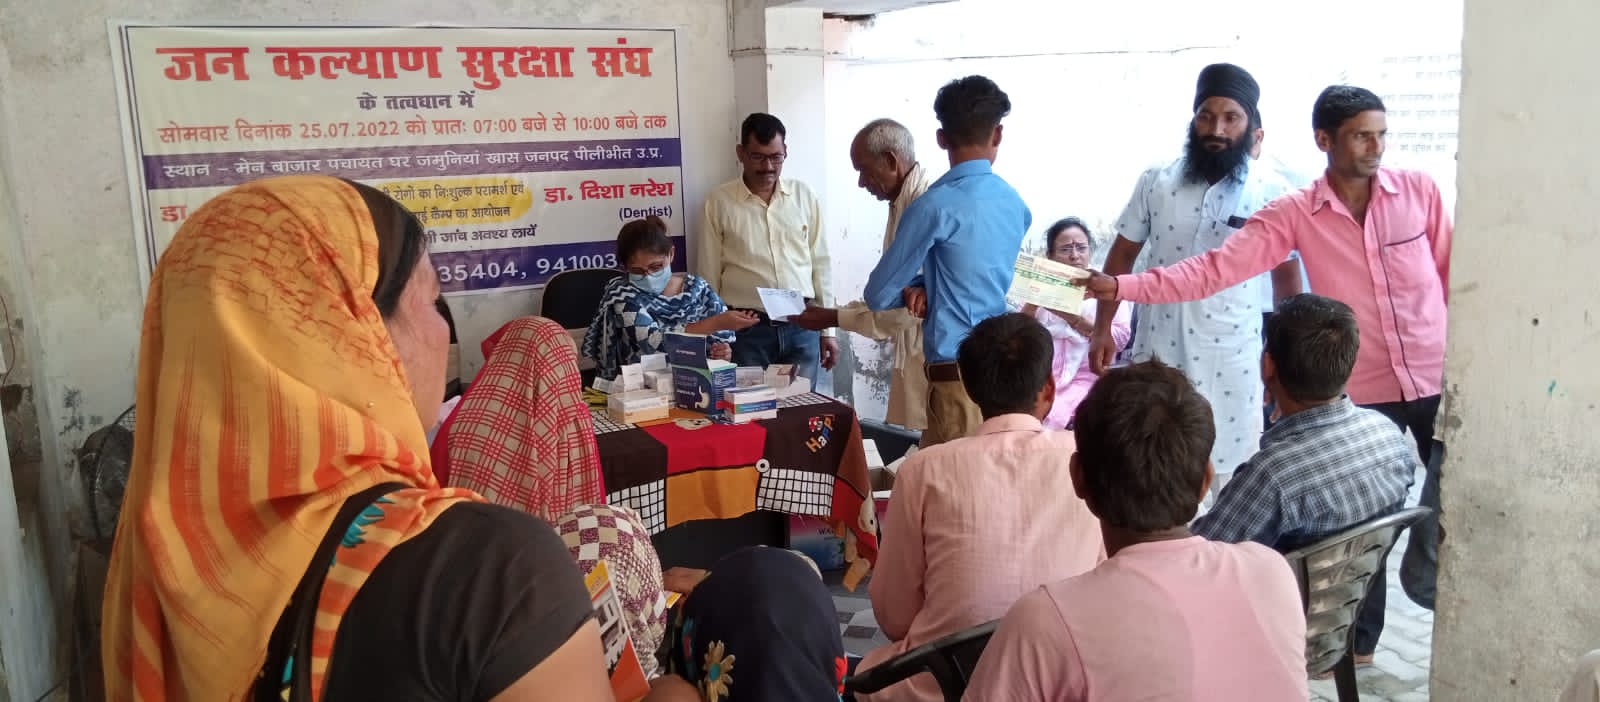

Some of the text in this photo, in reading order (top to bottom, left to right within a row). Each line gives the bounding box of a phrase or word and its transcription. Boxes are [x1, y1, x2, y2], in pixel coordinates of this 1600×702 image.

[156, 37, 653, 90] जन कल्याण सुरक्षा संघ
[356, 91, 378, 110] के
[457, 90, 476, 109] में
[157, 120, 229, 143] सोमवार
[235, 117, 292, 141] दिनांक
[299, 120, 400, 138] 25.07.2022
[405, 113, 427, 135] को
[473, 119, 517, 134] 07:00
[520, 112, 547, 131] बजे
[552, 111, 566, 131] से
[573, 116, 610, 130] 10:00
[614, 110, 639, 130] बजे
[642, 115, 667, 129] तक
[163, 163, 210, 177] स्थान
[271, 158, 321, 173] बाजार
[390, 155, 410, 167] घर
[486, 153, 520, 165] खास
[524, 149, 569, 163] जनपद
[574, 145, 632, 161] पीलीभीत
[636, 146, 663, 159] उ.प्र.
[418, 188, 431, 200] का
[511, 181, 524, 196] एवं
[544, 178, 674, 204] डा. दिशा नरेश
[455, 207, 468, 219] का
[472, 203, 511, 219] आयोजन
[619, 205, 673, 221] (Dentist)
[471, 229, 509, 242] अवश्य
[511, 223, 538, 240] लायें
